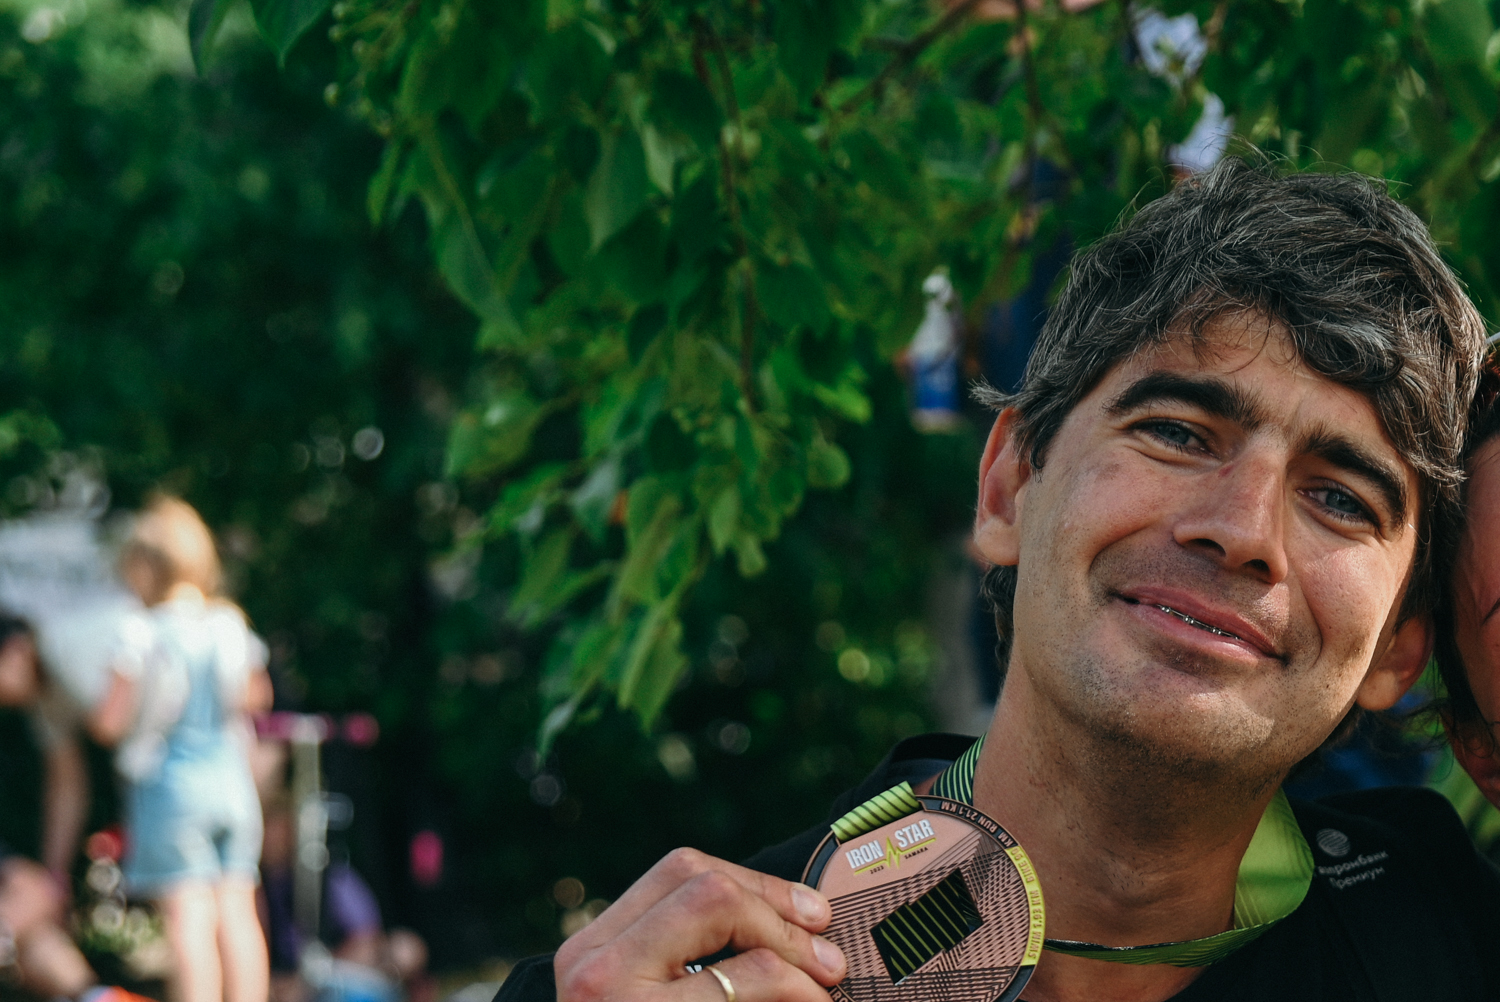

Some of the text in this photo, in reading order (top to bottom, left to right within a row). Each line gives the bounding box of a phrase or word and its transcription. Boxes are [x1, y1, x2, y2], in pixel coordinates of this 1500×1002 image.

[941, 800, 959, 813] KM
[958, 805, 979, 821] 21.1
[977, 815, 999, 834] RUN
[845, 819, 935, 869] IRON STAR
[999, 831, 1014, 847] KM
[904, 847, 929, 859] SAMARA
[1018, 860, 1036, 884] BIKE
